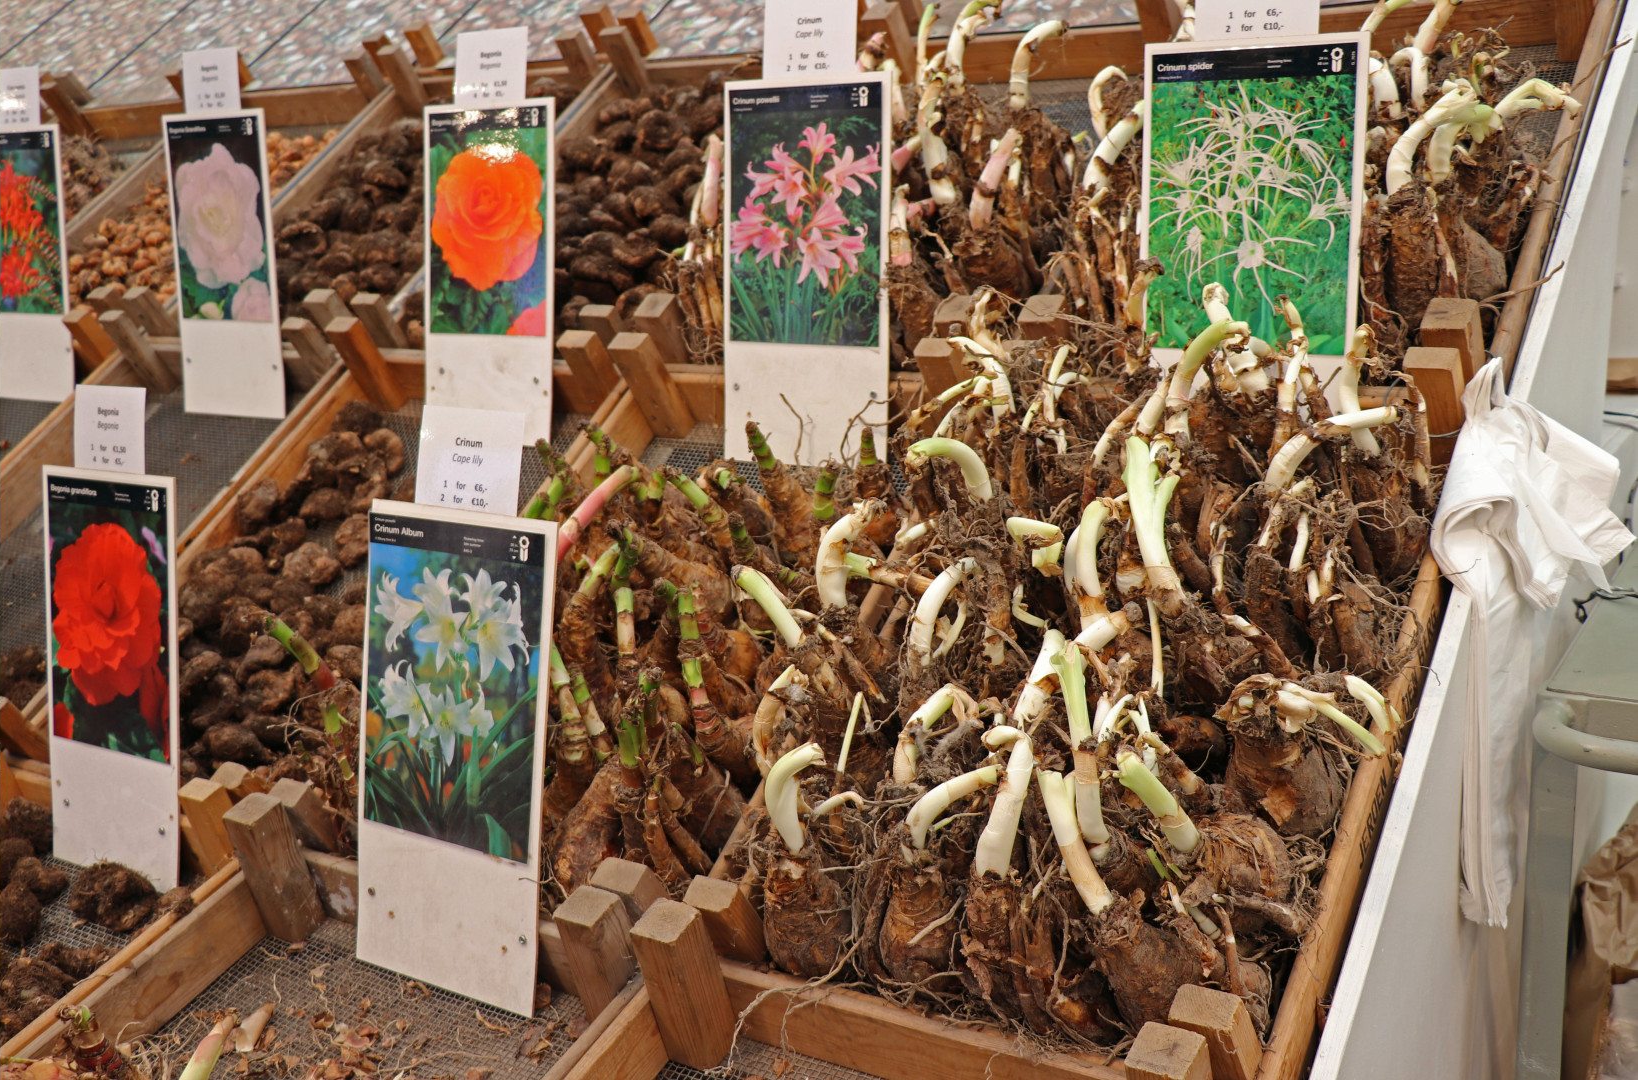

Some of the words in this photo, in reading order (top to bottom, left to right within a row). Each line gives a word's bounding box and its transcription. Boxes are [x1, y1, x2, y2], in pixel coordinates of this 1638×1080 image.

[1244, 10, 1256, 18] for
[1266, 9, 1282, 17] €6,-
[798, 16, 822, 24] Crinum
[1264, 22, 1284, 31] €10,-
[796, 30, 812, 38] Cape
[1157, 64, 1186, 72] Crinum
[1188, 62, 1214, 72] spider
[733, 97, 755, 105] Crinum
[98, 407, 119, 416] Begonia
[98, 421, 119, 430] Begonia
[456, 437, 482, 448] Crinum
[452, 453, 470, 464] Cape
[472, 455, 483, 466] lily
[50, 484, 70, 493] Begonia
[456, 482, 466, 490] for
[474, 483, 488, 493] €6,-
[454, 496, 463, 504] for
[472, 497, 488, 508] €10,-
[374, 524, 399, 534] Crinum
[401, 527, 424, 537] Album
[1360, 768, 1387, 870] JEROEN
